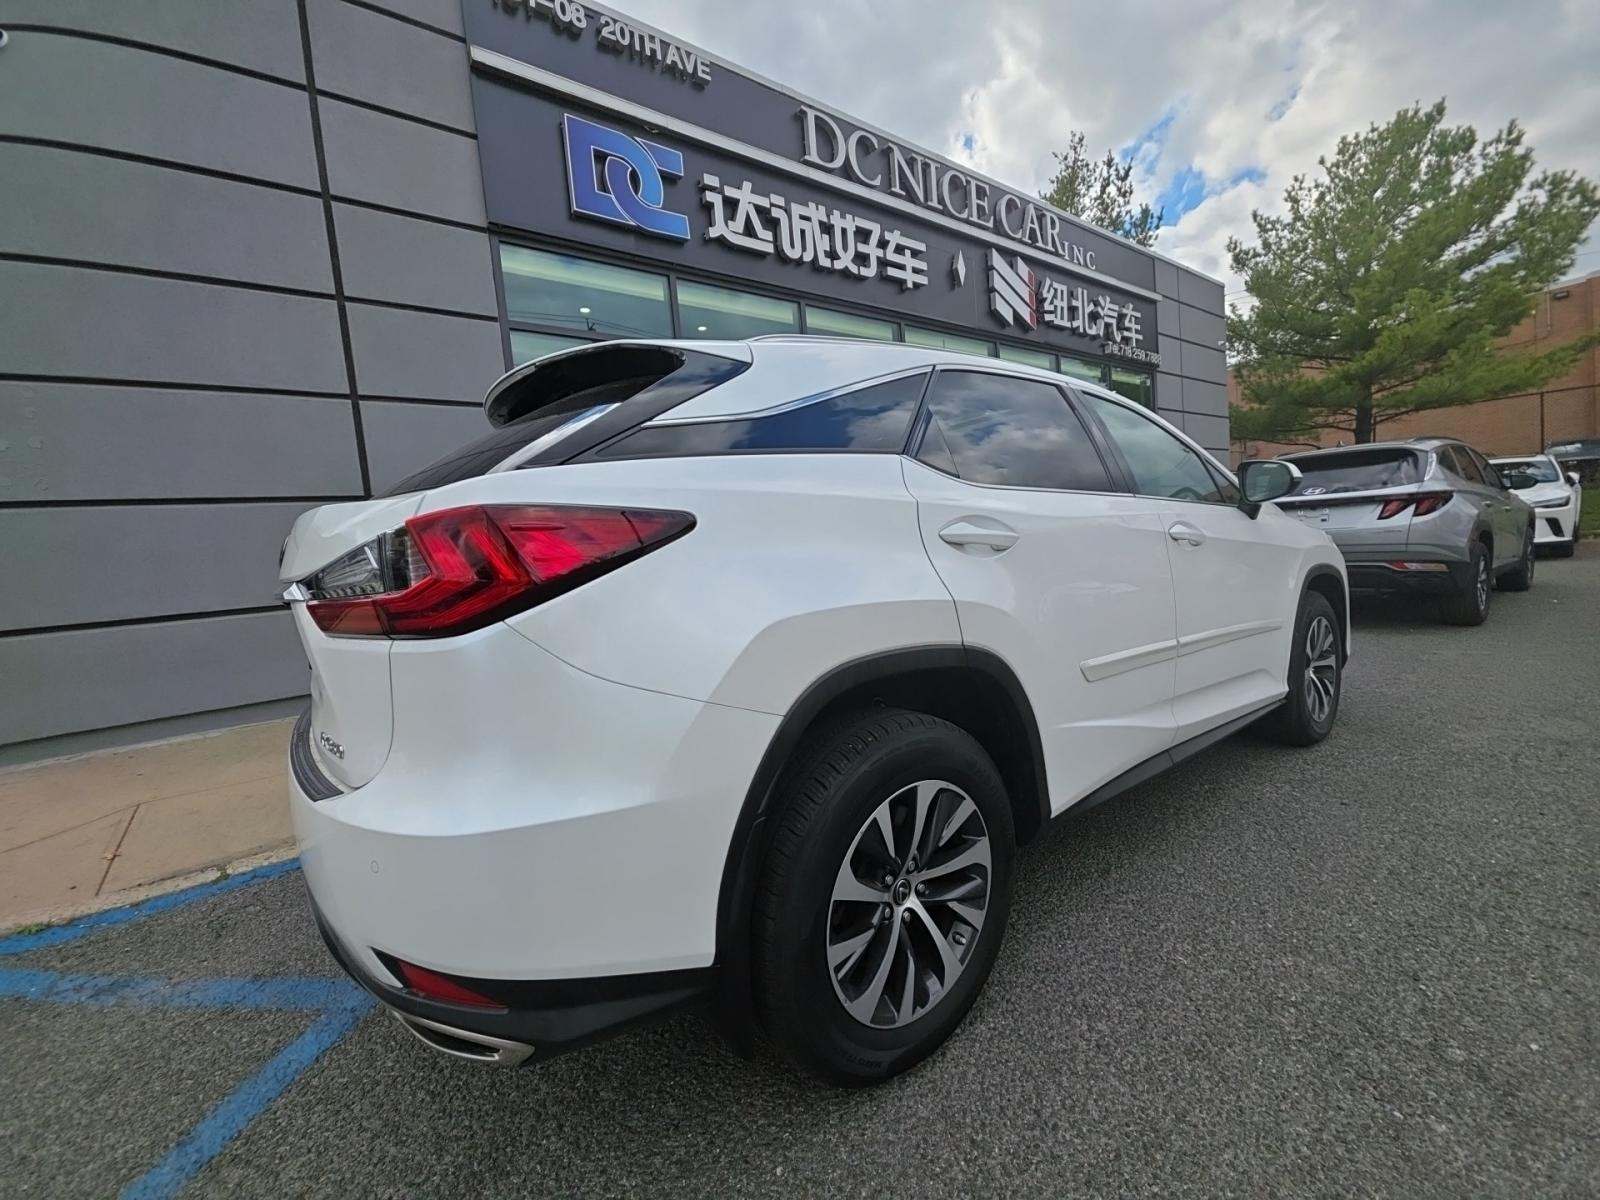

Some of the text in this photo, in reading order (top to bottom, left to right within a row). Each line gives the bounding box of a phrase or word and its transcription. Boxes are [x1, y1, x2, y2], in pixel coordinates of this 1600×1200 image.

[600, 15, 662, 60] 20TH
[666, 45, 712, 81] AVE
[701, 172, 929, 290] 达诚好车
[800, 105, 1096, 270] DC NICE CAR INC
[1041, 277, 1143, 346] 纽北汽车
